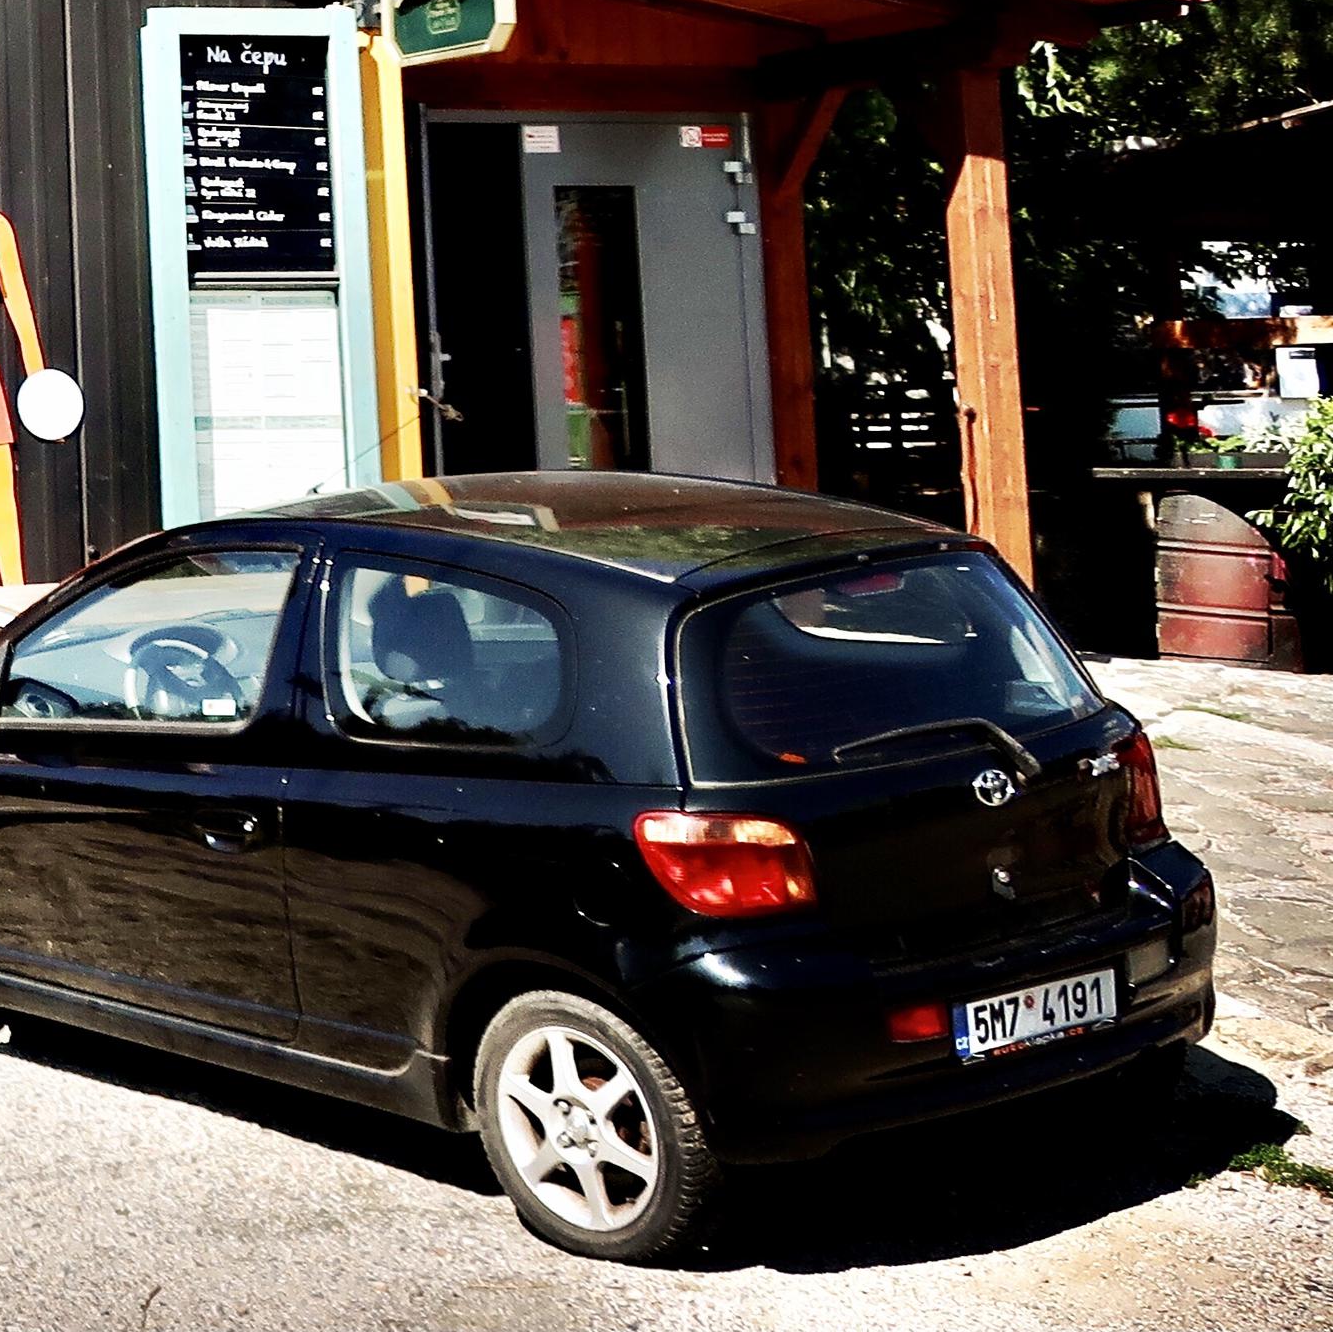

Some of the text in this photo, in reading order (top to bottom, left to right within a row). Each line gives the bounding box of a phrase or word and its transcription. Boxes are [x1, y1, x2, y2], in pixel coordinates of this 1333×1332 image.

[206, 42, 288, 74] Na čepu
[973, 976, 1103, 1045] 5M7 4191
